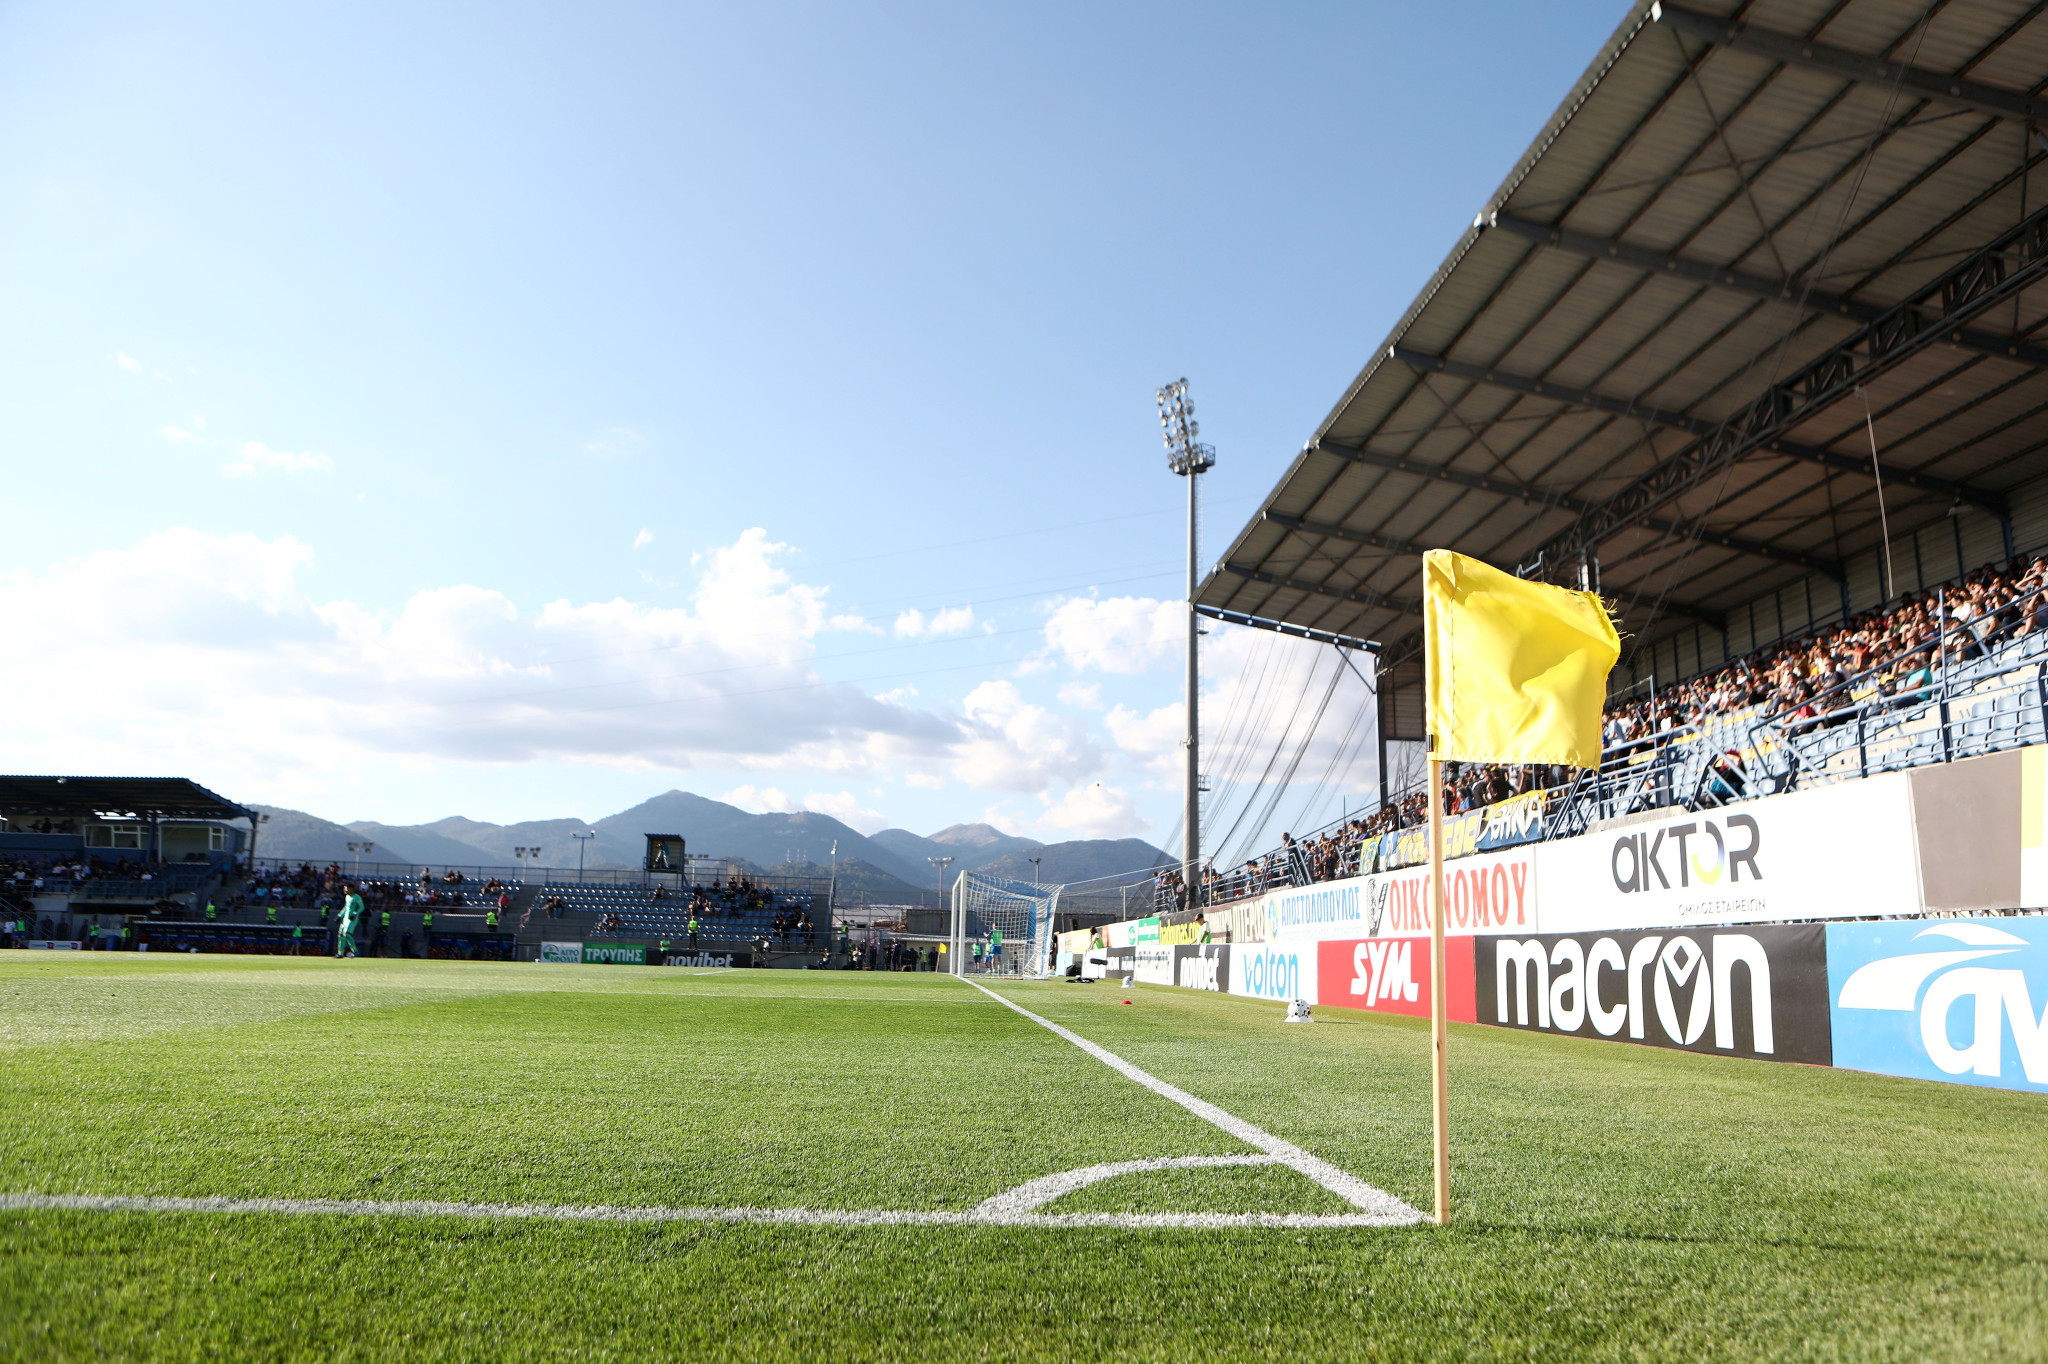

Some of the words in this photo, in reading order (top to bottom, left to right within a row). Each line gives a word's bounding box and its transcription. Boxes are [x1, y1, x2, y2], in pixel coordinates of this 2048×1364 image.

[1281, 886, 1361, 926] ΑΠΟΣΤΟΛΟΠΟΥΛΟΣ
[1678, 901, 1714, 916] ΟΜΙΛΟΣ
[585, 948, 643, 962] ΤΡΟΥΠΗΣ
[666, 952, 734, 968] novibet
[1180, 945, 1220, 992] novibet
[1244, 947, 1298, 998] volton
[1350, 941, 1419, 1007] SYM
[1496, 934, 1774, 1055] macron
